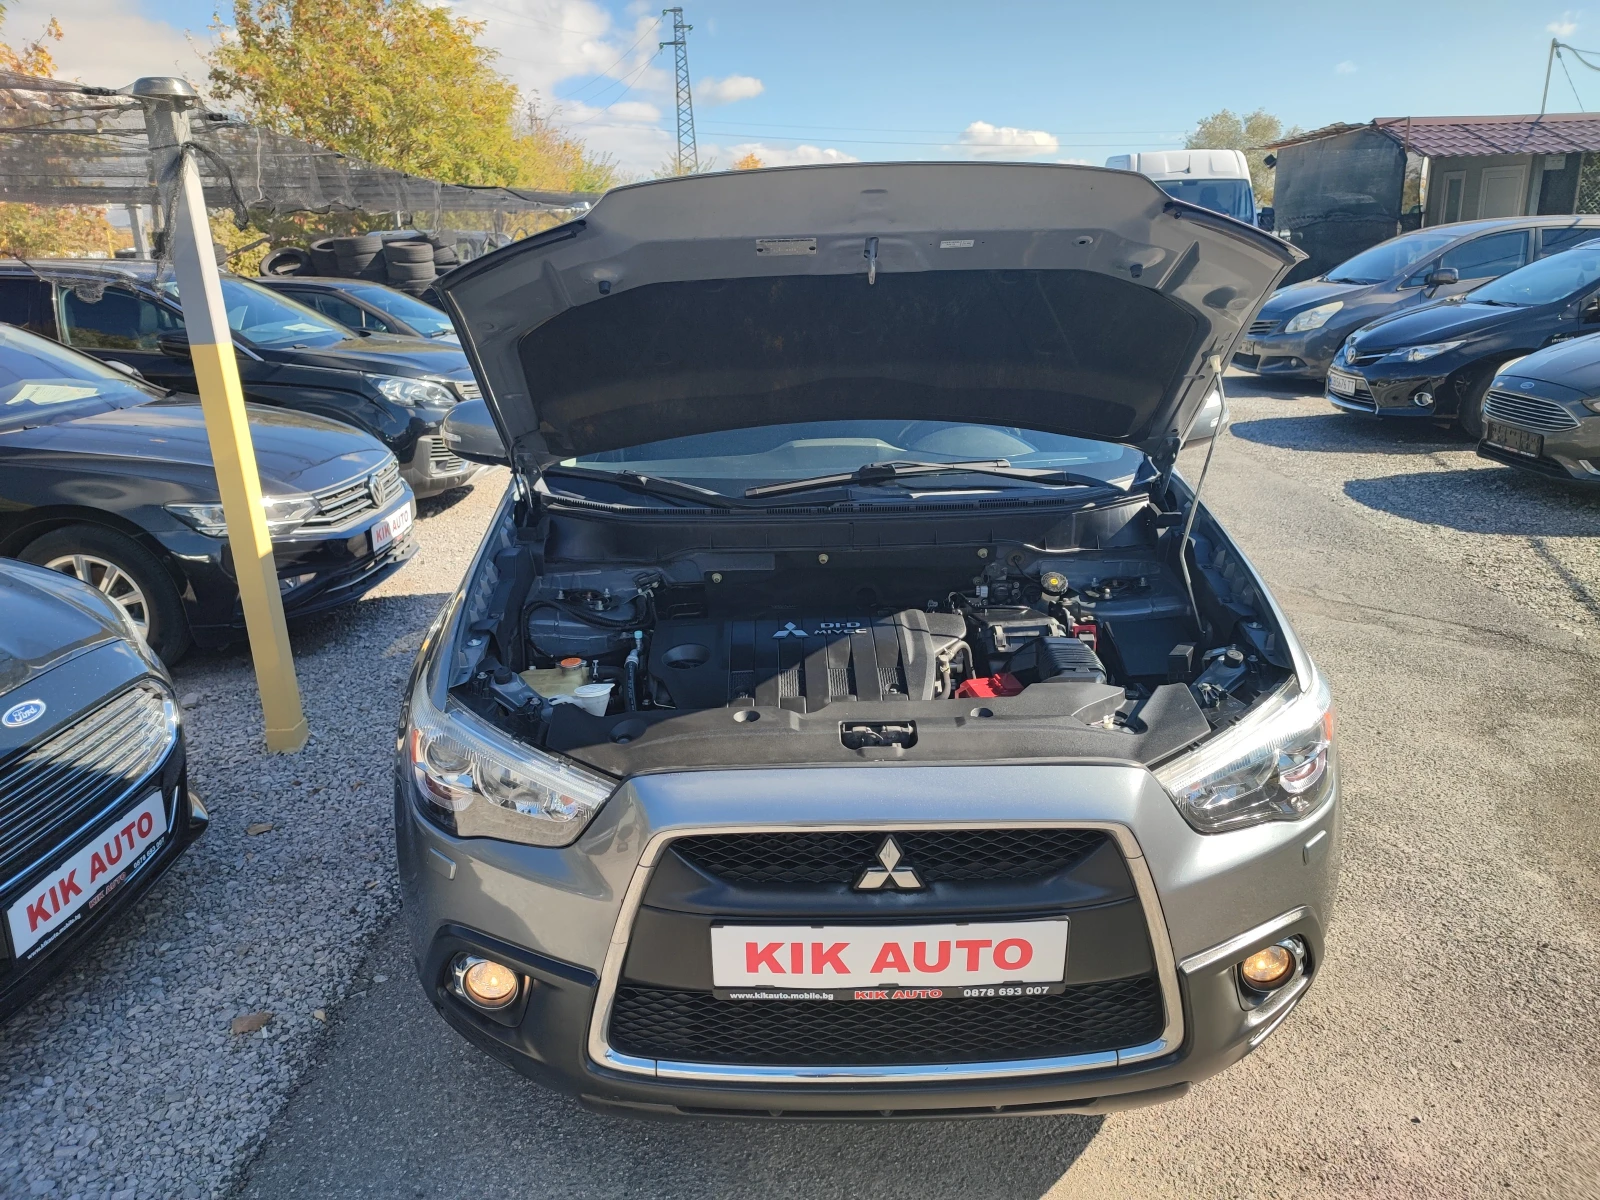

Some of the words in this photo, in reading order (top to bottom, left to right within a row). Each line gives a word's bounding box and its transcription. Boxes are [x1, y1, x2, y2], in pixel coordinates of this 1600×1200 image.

[376, 523, 391, 543] KIK
[393, 510, 408, 532] AUTO
[12, 704, 38, 722] Ford
[26, 868, 83, 933] KIK
[89, 811, 153, 884] AUTO
[745, 941, 851, 975] KIK
[869, 938, 1034, 974] AUTO
[729, 990, 834, 1001] www.kikauto.mobile.bg
[854, 989, 888, 1000] KIK
[892, 989, 943, 999] AUTO
[963, 988, 996, 997] 0878
[998, 987, 1022, 997] 693
[1025, 986, 1050, 996] 007
